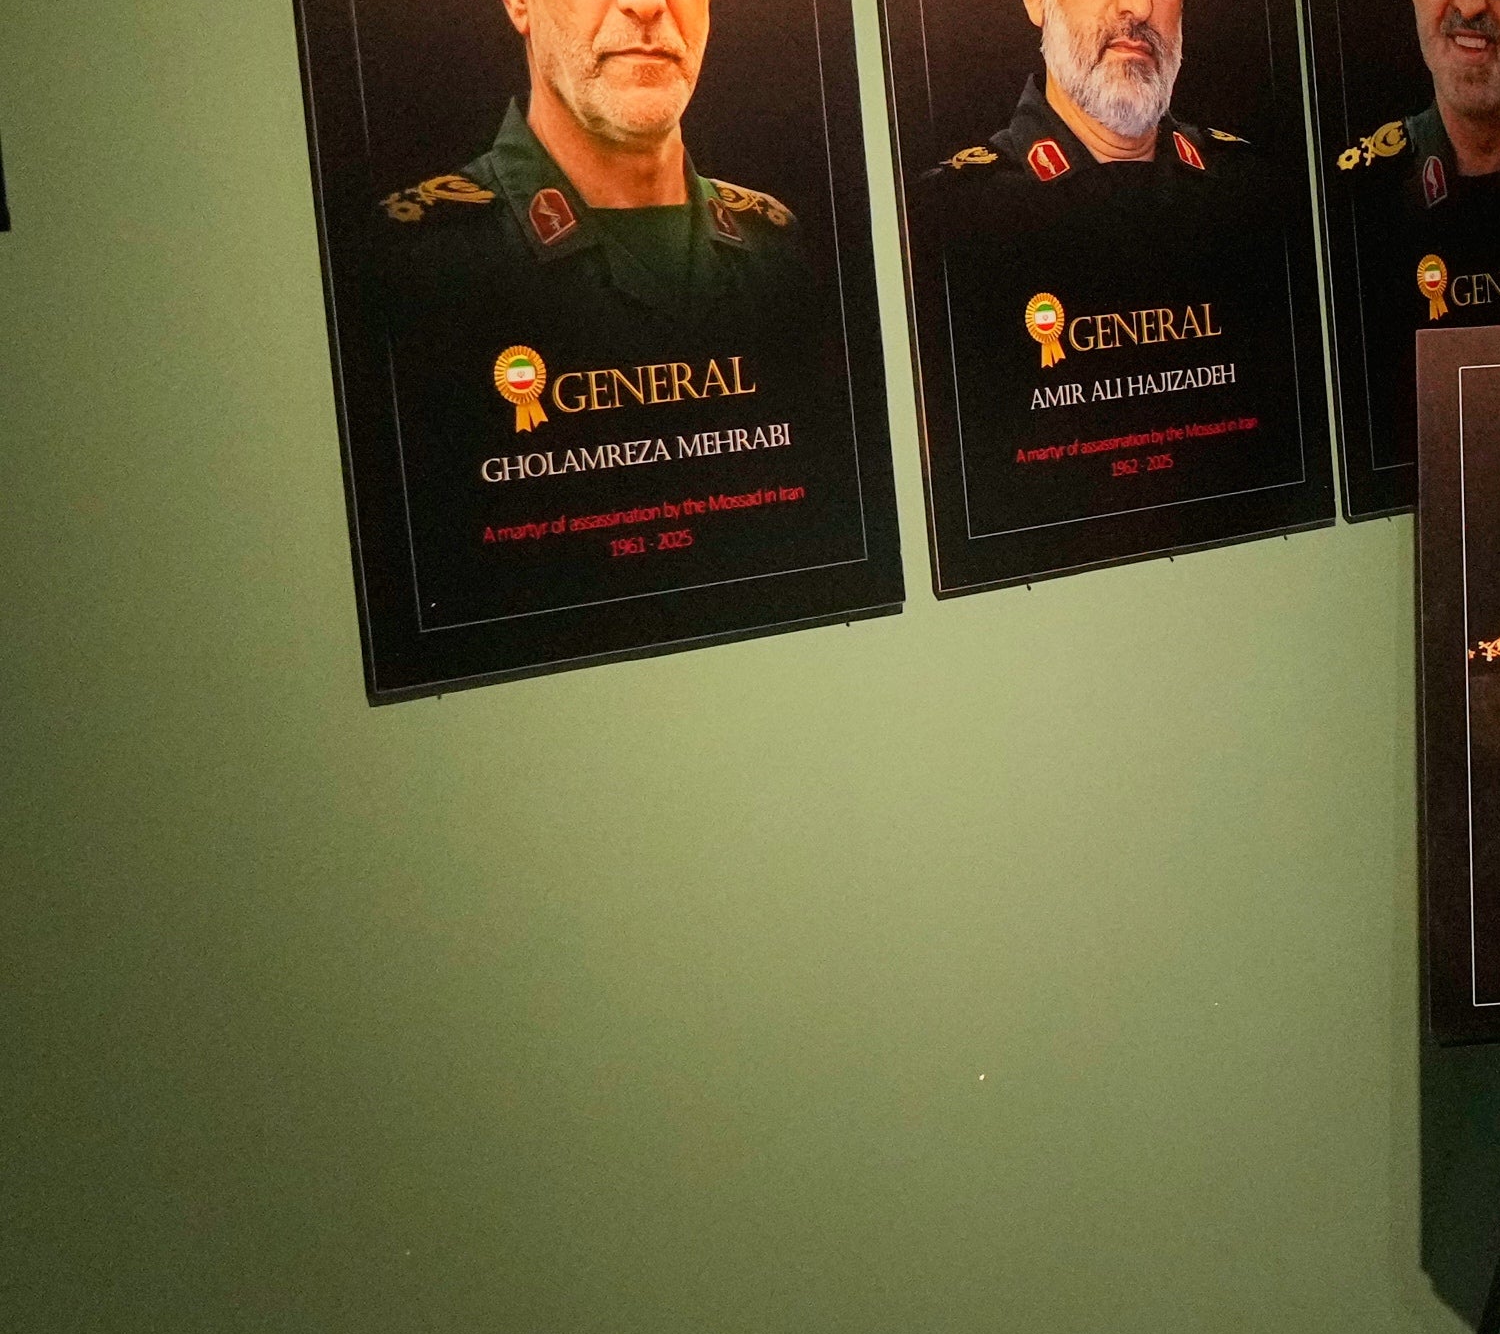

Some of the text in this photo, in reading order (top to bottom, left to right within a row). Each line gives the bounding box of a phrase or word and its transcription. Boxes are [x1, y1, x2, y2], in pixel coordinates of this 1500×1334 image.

[1068, 303, 1222, 352] GENERAL
[552, 356, 756, 413] GENERAL
[1030, 363, 1236, 410] AMIR ALI HAJIZADEH
[481, 423, 792, 483] GHOLAMREZA MEHRABI
[484, 483, 804, 543] A martyr of assassination by the Mossad in Iran
